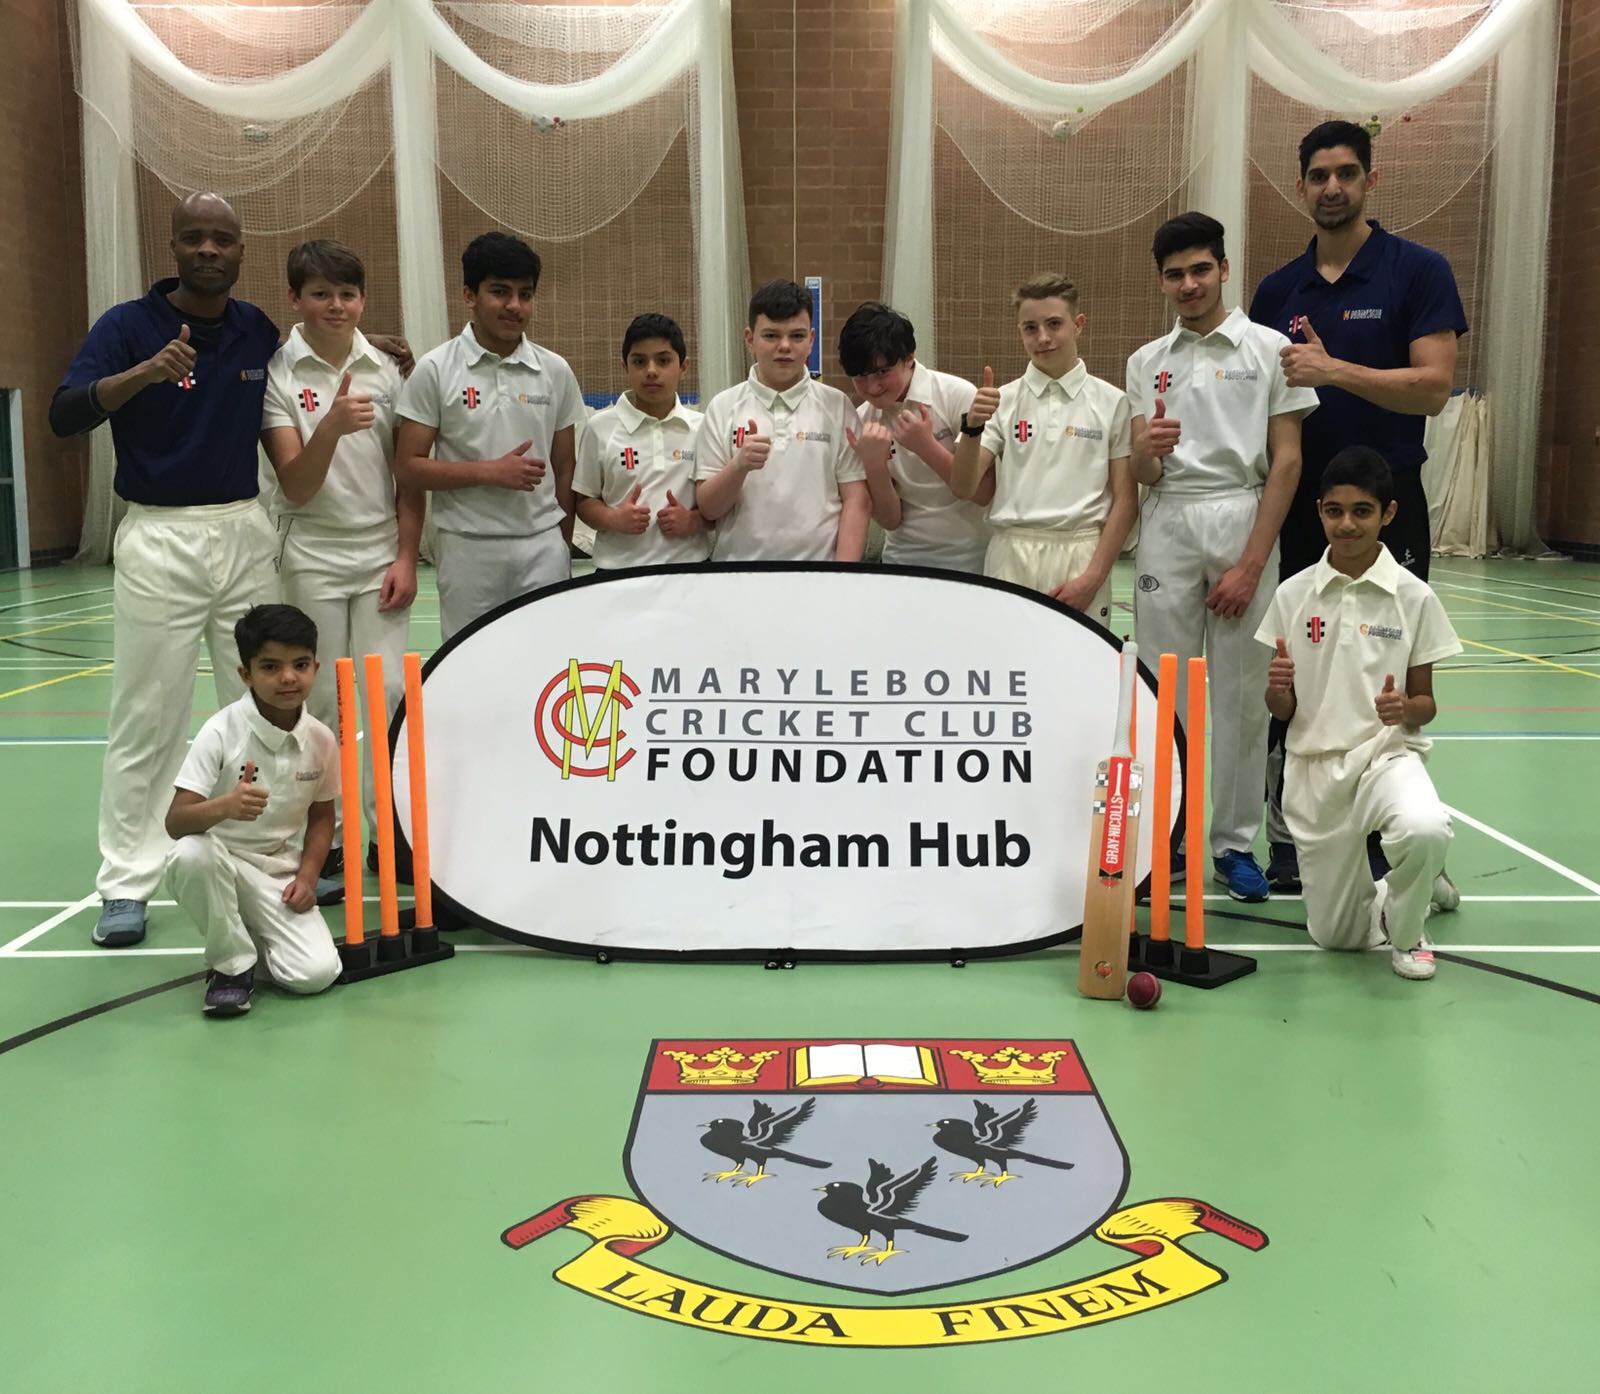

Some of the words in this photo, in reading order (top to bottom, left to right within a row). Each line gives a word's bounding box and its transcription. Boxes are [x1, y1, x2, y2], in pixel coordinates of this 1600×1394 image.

[651, 667, 1027, 697] MARYLEBONE
[645, 708, 870, 737] CRICKET
[904, 710, 1032, 738] CLUB
[647, 747, 1032, 784] FOUNDATION
[530, 816, 890, 880] Nottingham
[909, 819, 1031, 868] Hub
[1105, 795, 1124, 865] GRAY-NICOLLS
[597, 1271, 852, 1338] LAUDA
[931, 1269, 1170, 1337] FINEM
